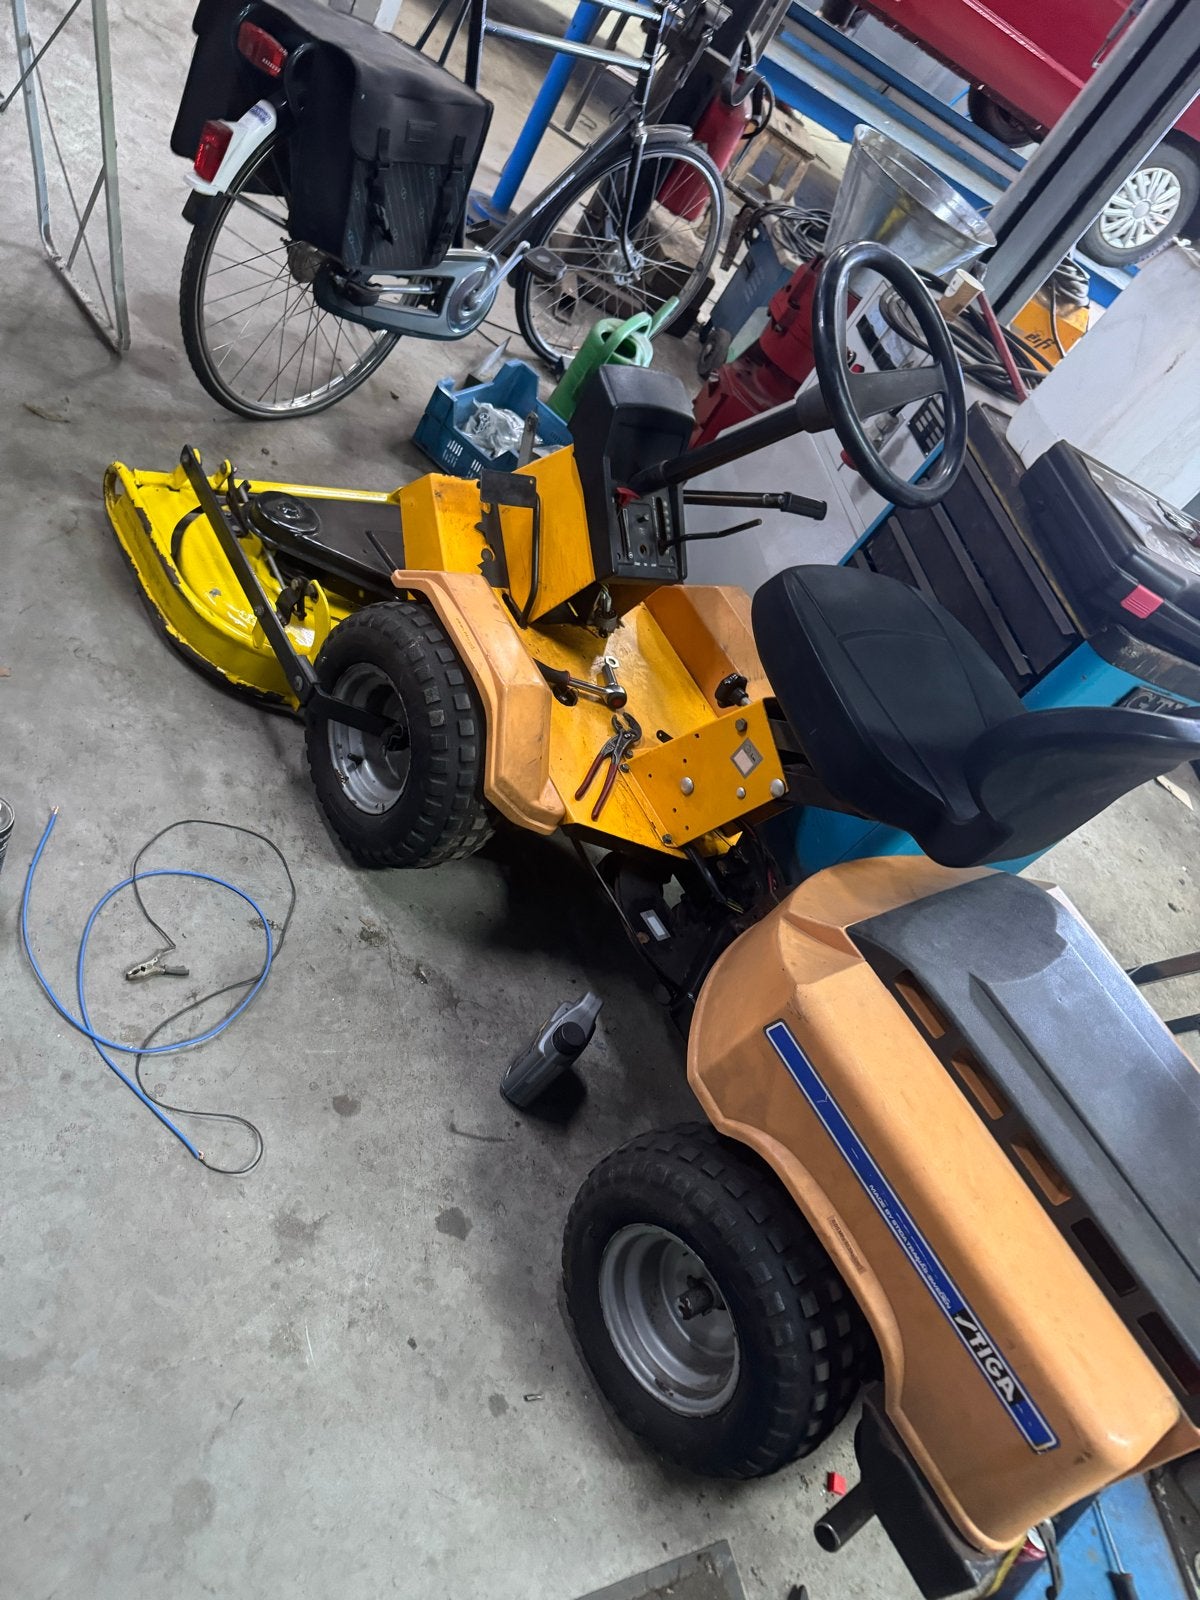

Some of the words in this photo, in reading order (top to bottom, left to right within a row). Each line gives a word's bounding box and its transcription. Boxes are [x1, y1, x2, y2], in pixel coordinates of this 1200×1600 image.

[869, 1184, 886, 1208] MADE
[884, 1208, 894, 1220] BY
[891, 1219, 908, 1242] STIGA
[954, 1314, 1014, 1402] STIGA
